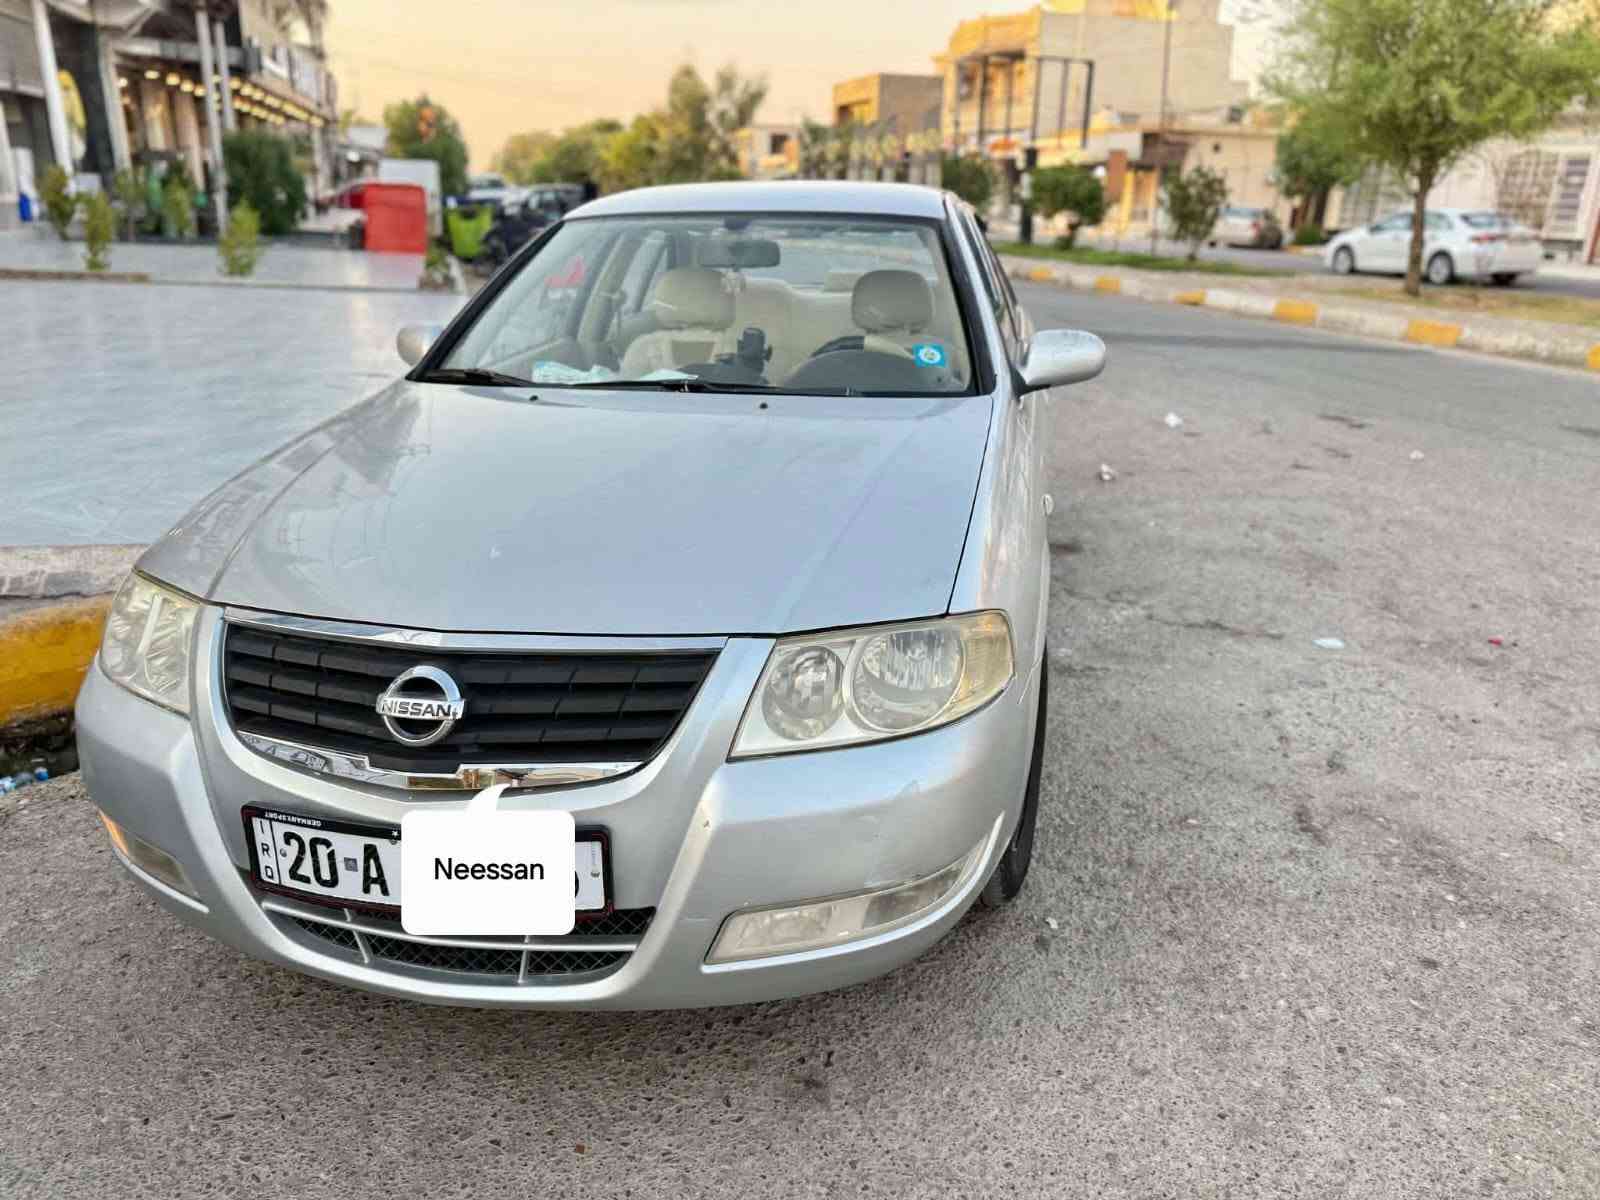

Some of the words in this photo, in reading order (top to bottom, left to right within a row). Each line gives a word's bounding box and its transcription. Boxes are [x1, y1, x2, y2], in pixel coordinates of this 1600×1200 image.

[381, 700, 452, 717] NISSAN
[283, 831, 340, 888] 20
[362, 844, 390, 896] A
